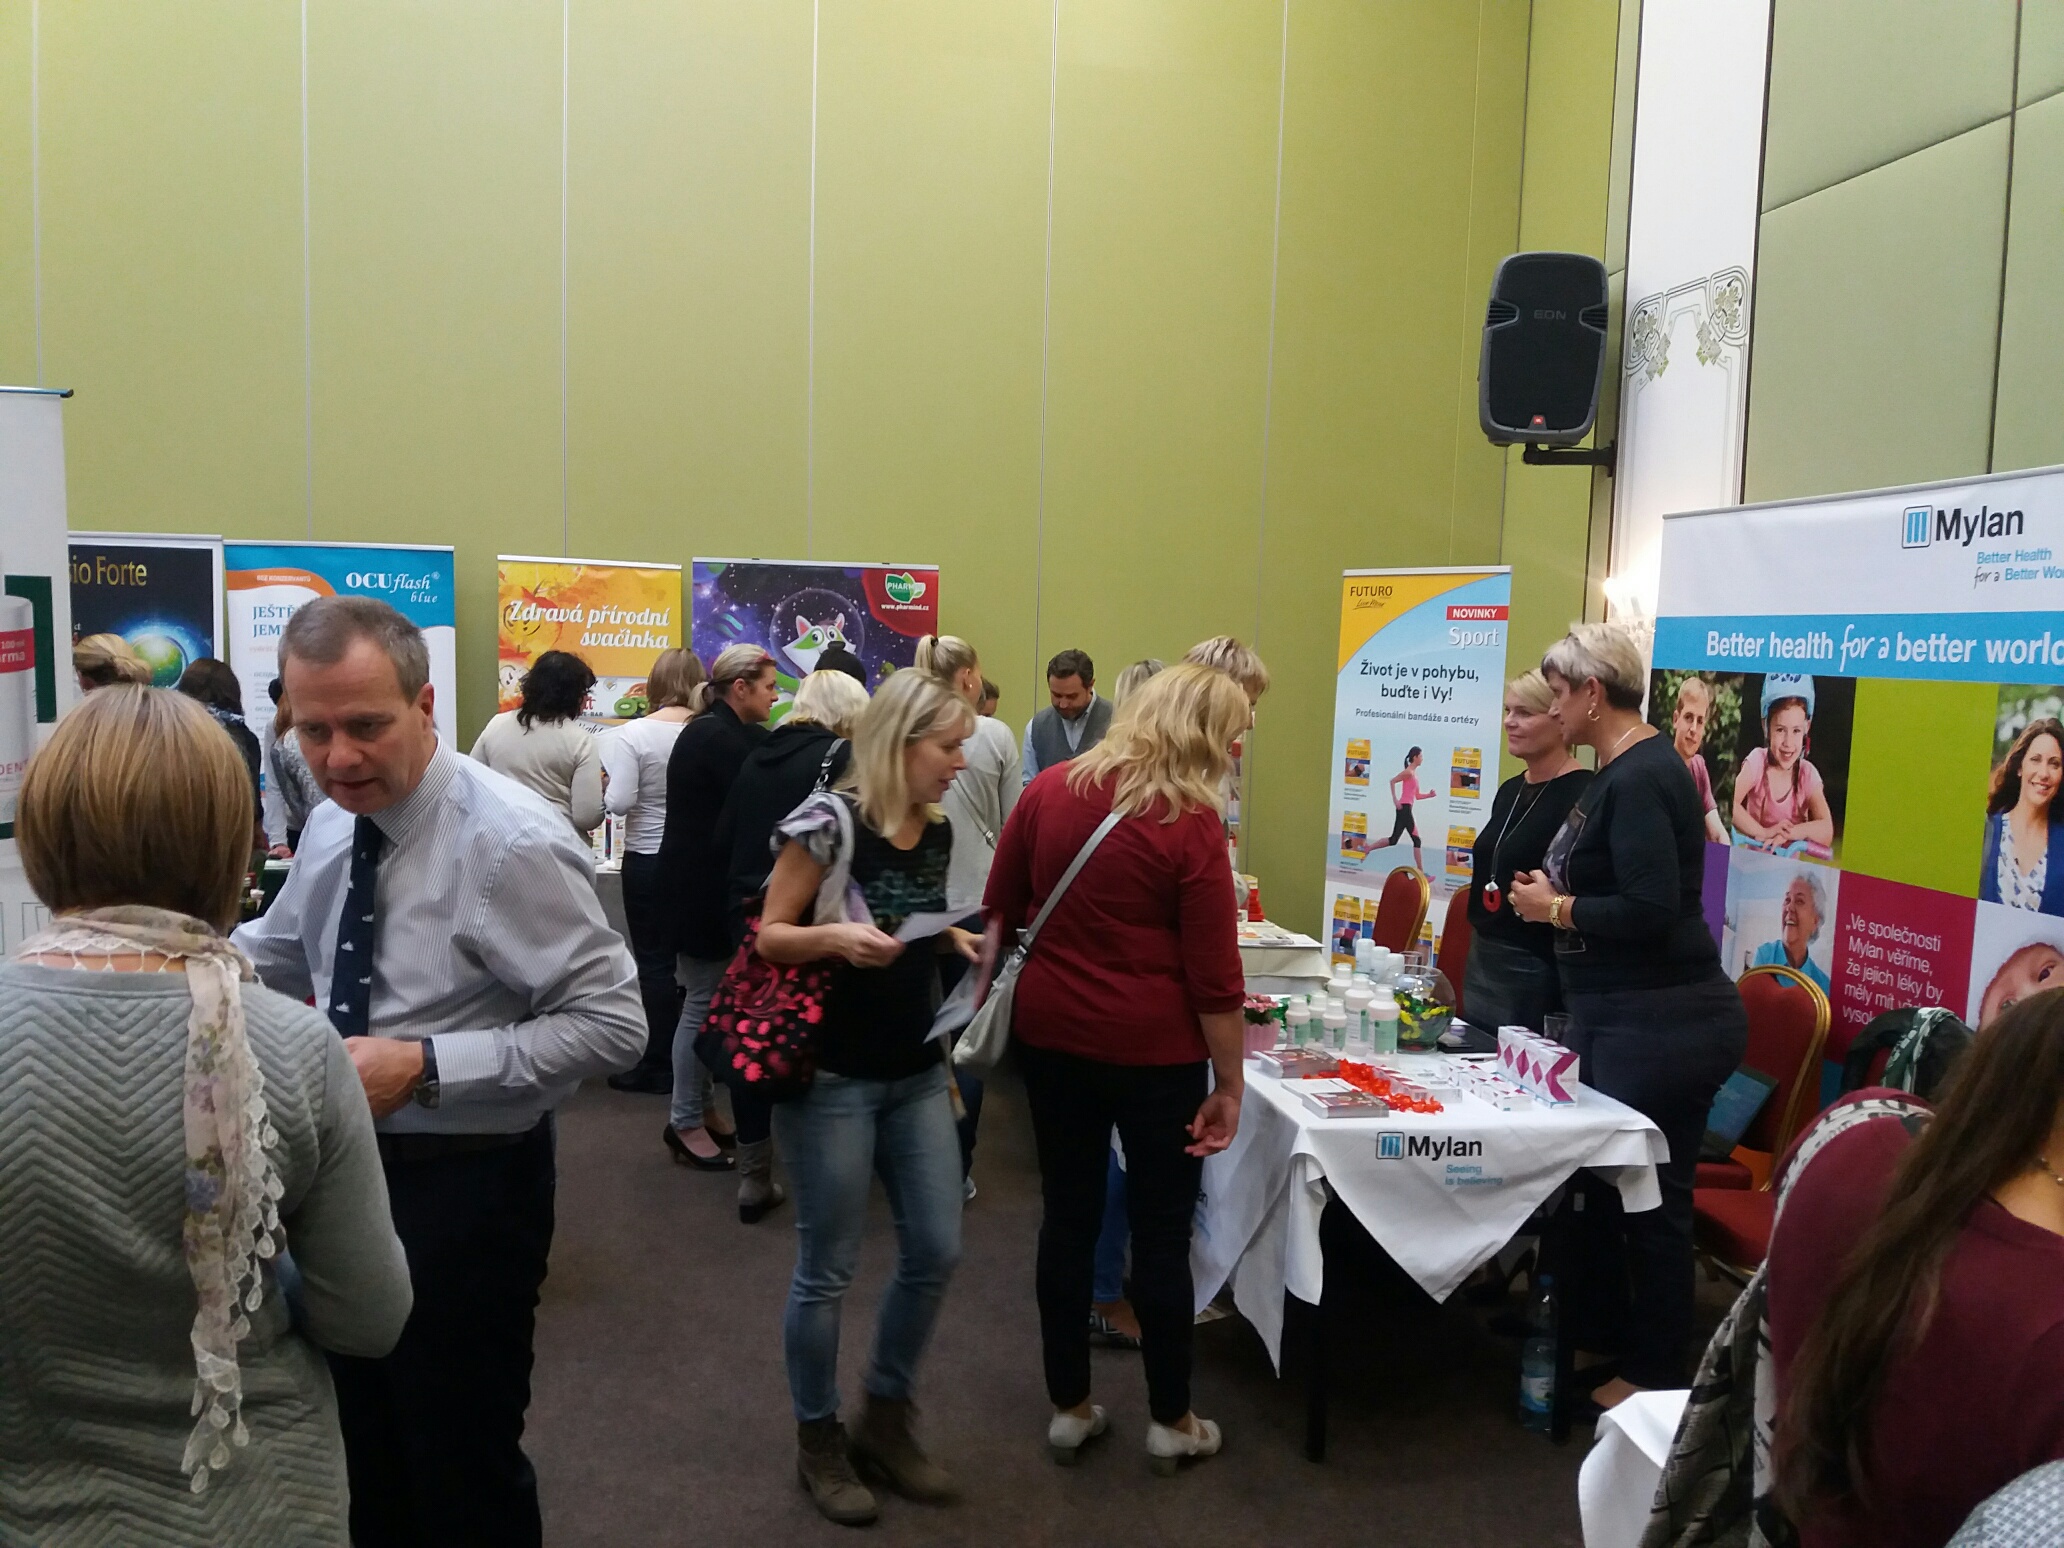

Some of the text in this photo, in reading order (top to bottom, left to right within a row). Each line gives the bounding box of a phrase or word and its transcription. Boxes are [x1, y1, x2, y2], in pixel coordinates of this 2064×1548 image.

[1935, 505, 2024, 547] Mylan
[1976, 548, 2052, 565] Better Health
[96, 556, 147, 587] Forte
[1974, 566, 1992, 589] for
[1994, 571, 2000, 582] a
[2004, 567, 2040, 581] Better
[410, 591, 438, 603] blue
[1350, 585, 1393, 597] FUTURO
[509, 600, 671, 629] Zdravá přírodní
[1452, 608, 1498, 619] NOVINKY
[580, 628, 670, 649] svačinka
[1449, 626, 1500, 649] Sport
[1707, 630, 1765, 658] Better
[1769, 631, 1833, 660] health
[1839, 624, 1876, 673] for
[1878, 636, 1890, 660] a
[1896, 631, 1977, 663] better
[1360, 659, 1479, 682] Život je v pohybu,
[1381, 684, 1453, 703] buďte i Vy!
[1355, 708, 1479, 727] Profesionální bandáže a ortézy
[1868, 922, 1941, 952] společnosti
[1849, 936, 1933, 977] Mylan věříme,
[1846, 958, 1860, 976] že
[1862, 963, 1893, 986] jejich
[1897, 973, 1923, 998] léky
[1926, 981, 1944, 1005] by
[1844, 984, 1872, 1006] měly
[1875, 992, 1894, 1010] mít
[1408, 1135, 1482, 1161] Mylan
[1446, 1164, 1482, 1175] Seeing
[1457, 1176, 1503, 1186] believing
